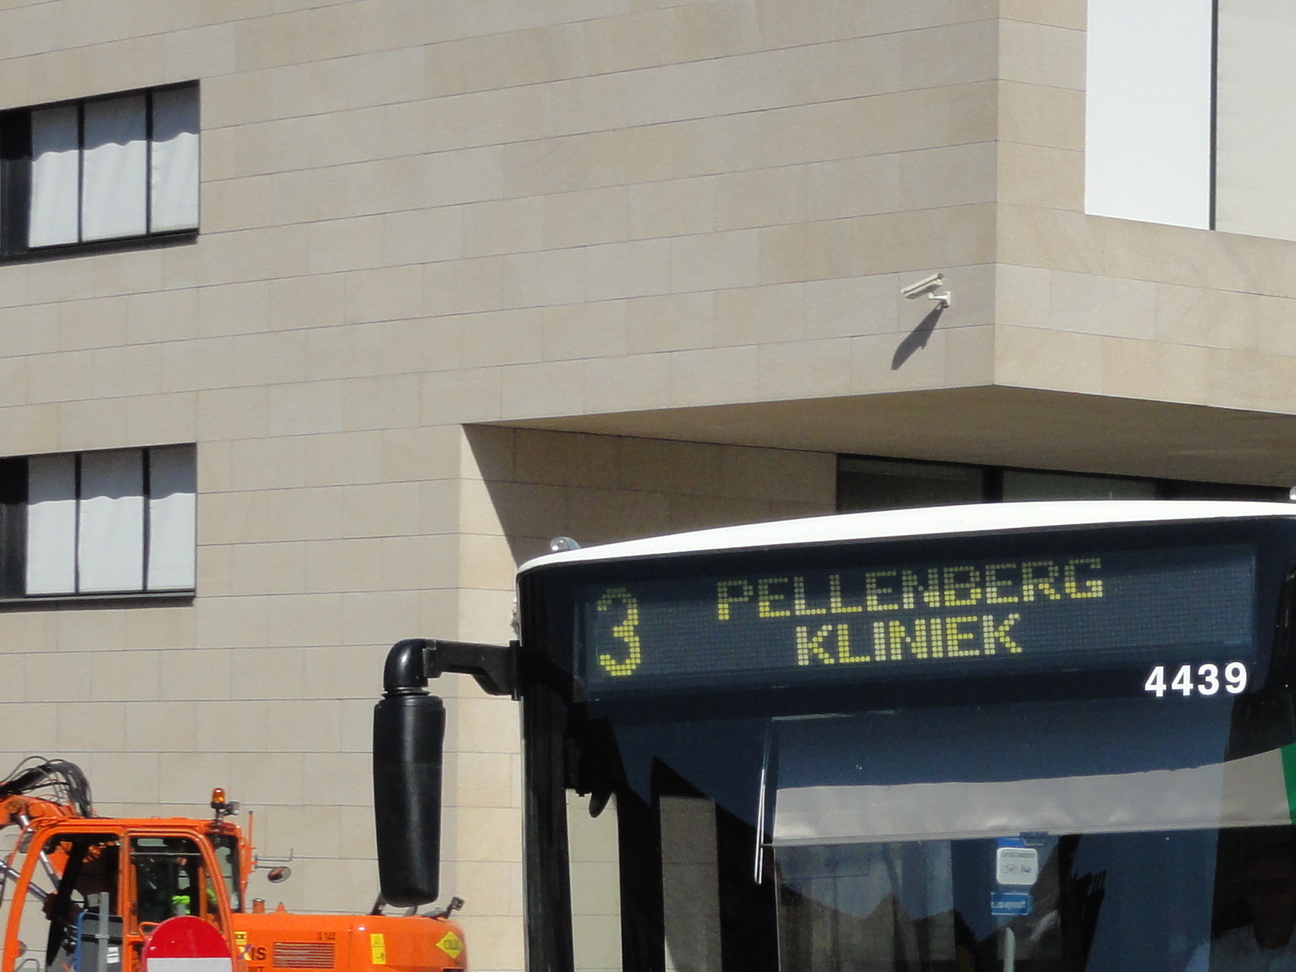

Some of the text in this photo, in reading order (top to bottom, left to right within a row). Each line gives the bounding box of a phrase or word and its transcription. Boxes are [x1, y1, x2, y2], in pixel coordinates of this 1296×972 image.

[596, 558, 1103, 676] 3 PELLENBERG
[796, 613, 1023, 666] KLINIEK
[1144, 661, 1248, 698] 4439
